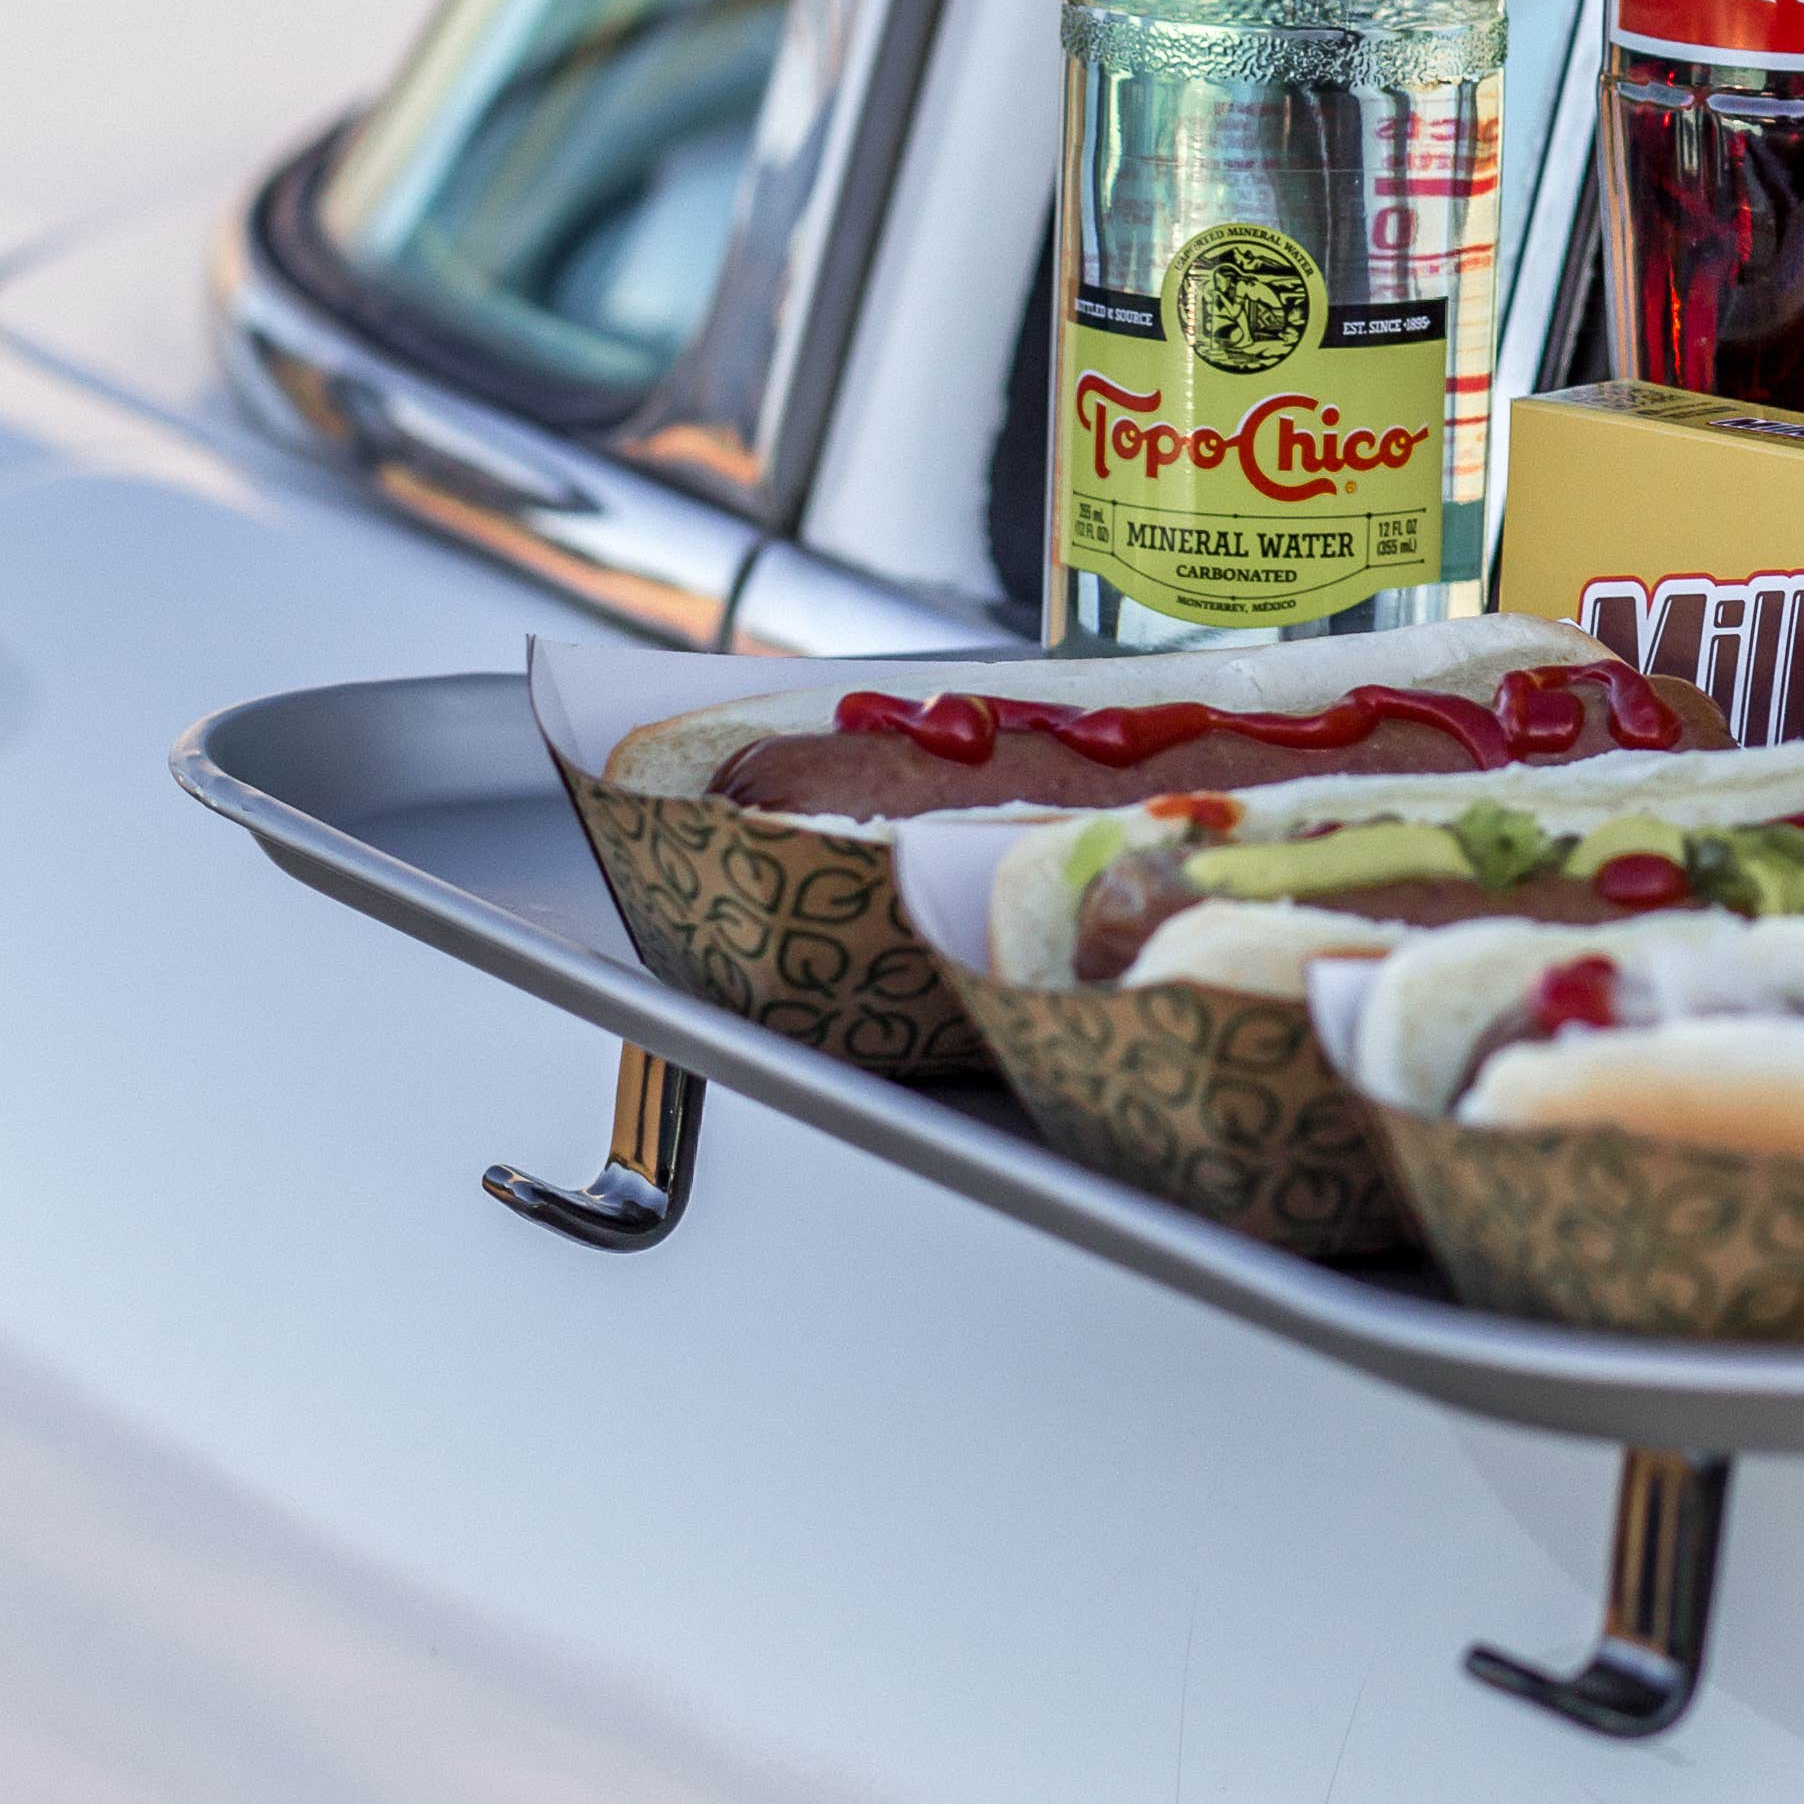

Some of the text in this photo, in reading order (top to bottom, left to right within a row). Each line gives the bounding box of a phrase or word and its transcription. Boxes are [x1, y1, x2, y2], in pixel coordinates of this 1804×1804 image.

[1227, 227, 1282, 246] MINERAL
[1283, 241, 1315, 278] WATER
[1114, 307, 1153, 326] SOURCE
[1342, 321, 1367, 335] EST.
[1368, 319, 1402, 334] SINCE
[1075, 368, 1430, 503] Topo Chico
[1378, 518, 1418, 538] 12 FL OZ
[1126, 521, 1355, 559] MINERAL WATER
[1376, 539, 1418, 556] (355 mL)
[1176, 565, 1298, 583] CARBONATED
[1176, 595, 1249, 613] MONTERREY,
